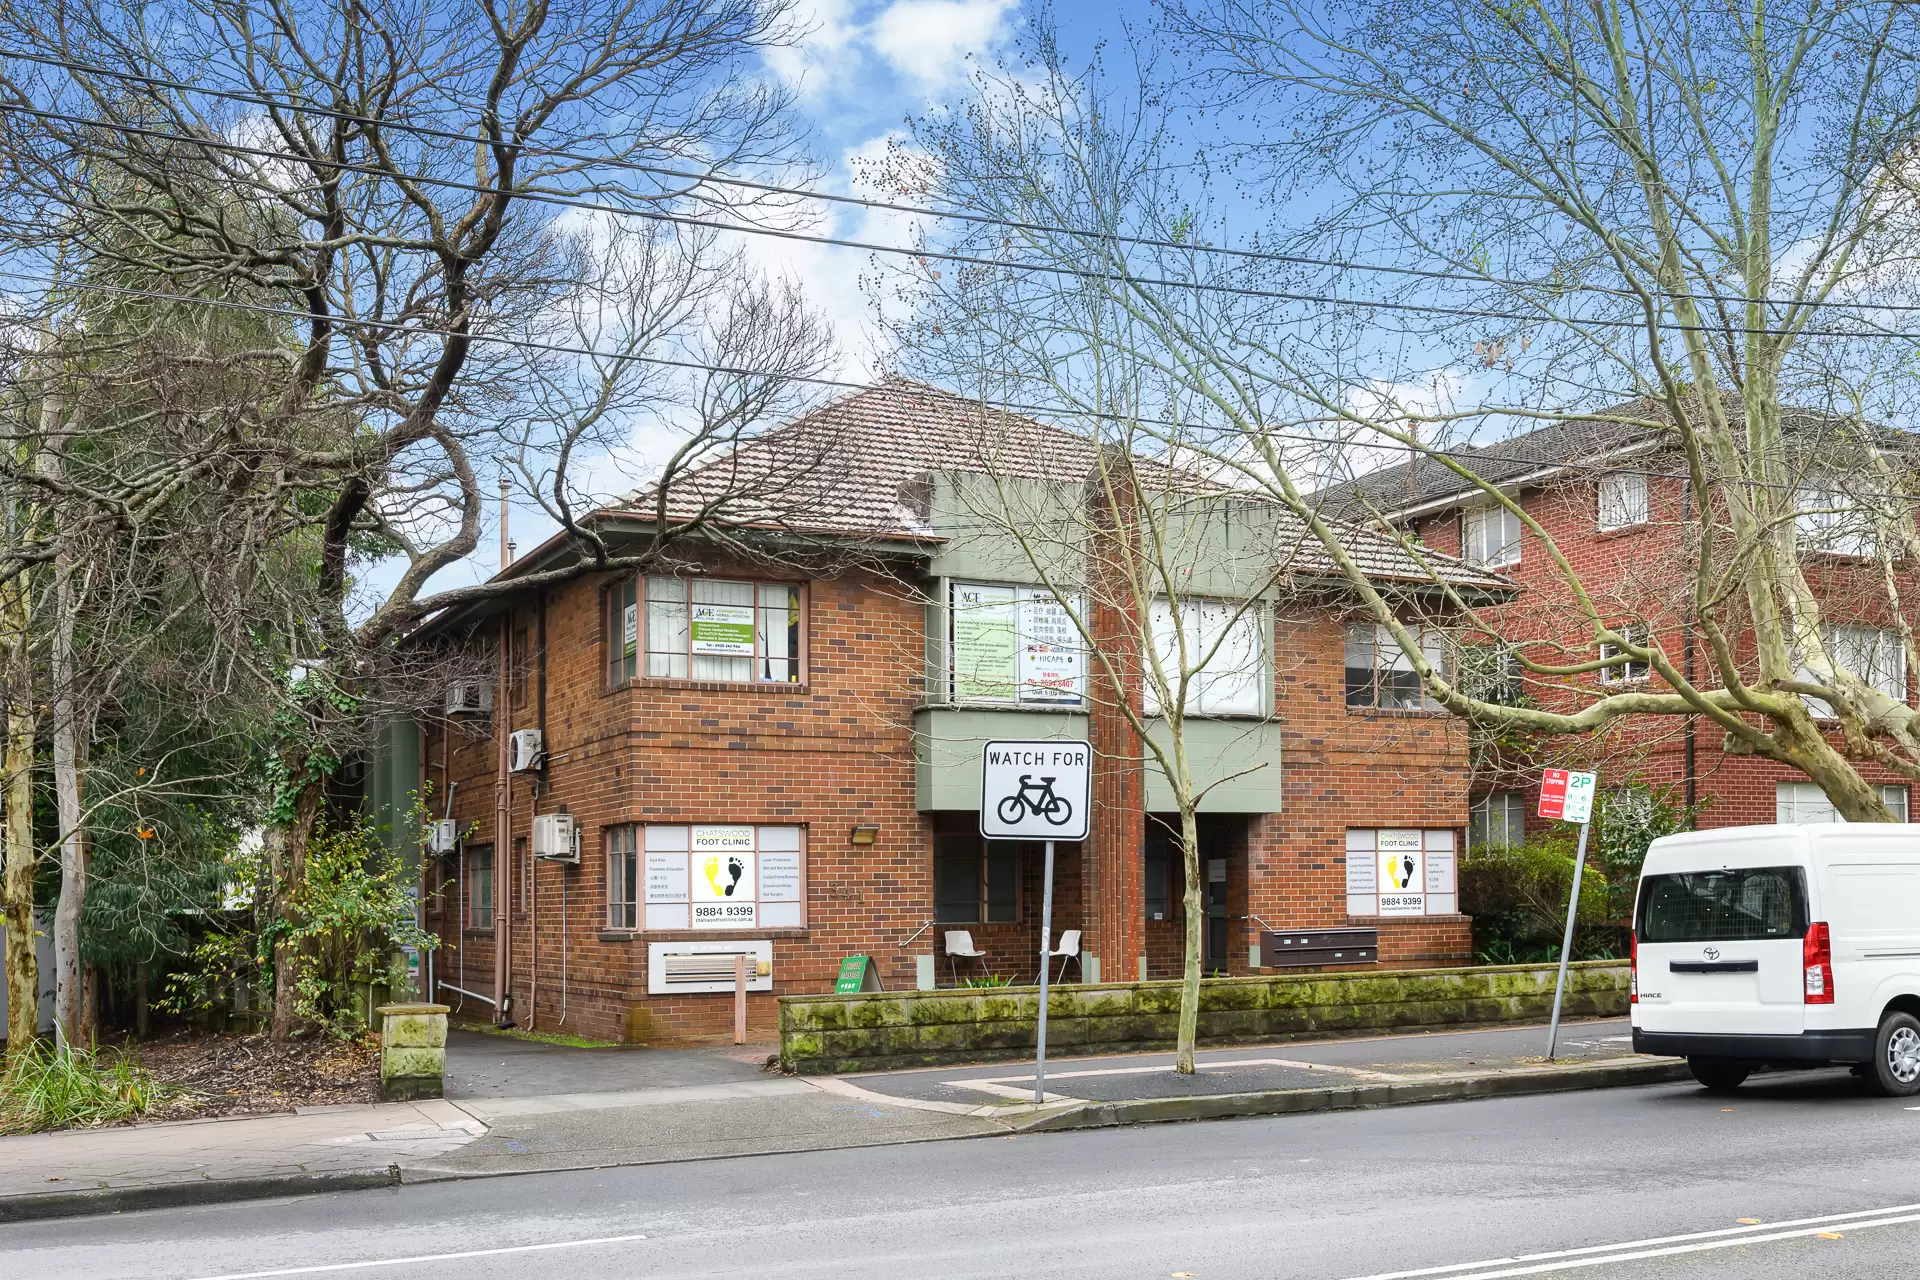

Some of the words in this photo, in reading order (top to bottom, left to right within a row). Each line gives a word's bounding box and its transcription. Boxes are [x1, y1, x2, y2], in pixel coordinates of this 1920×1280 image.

[962, 592, 980, 602] ACE
[696, 607, 714, 617] ACE
[990, 752, 1044, 766] WATCH
[1054, 752, 1084, 766] FOR
[1571, 776, 1591, 788] 2P
[696, 907, 722, 916] 9884
[726, 907, 753, 915] 9399
